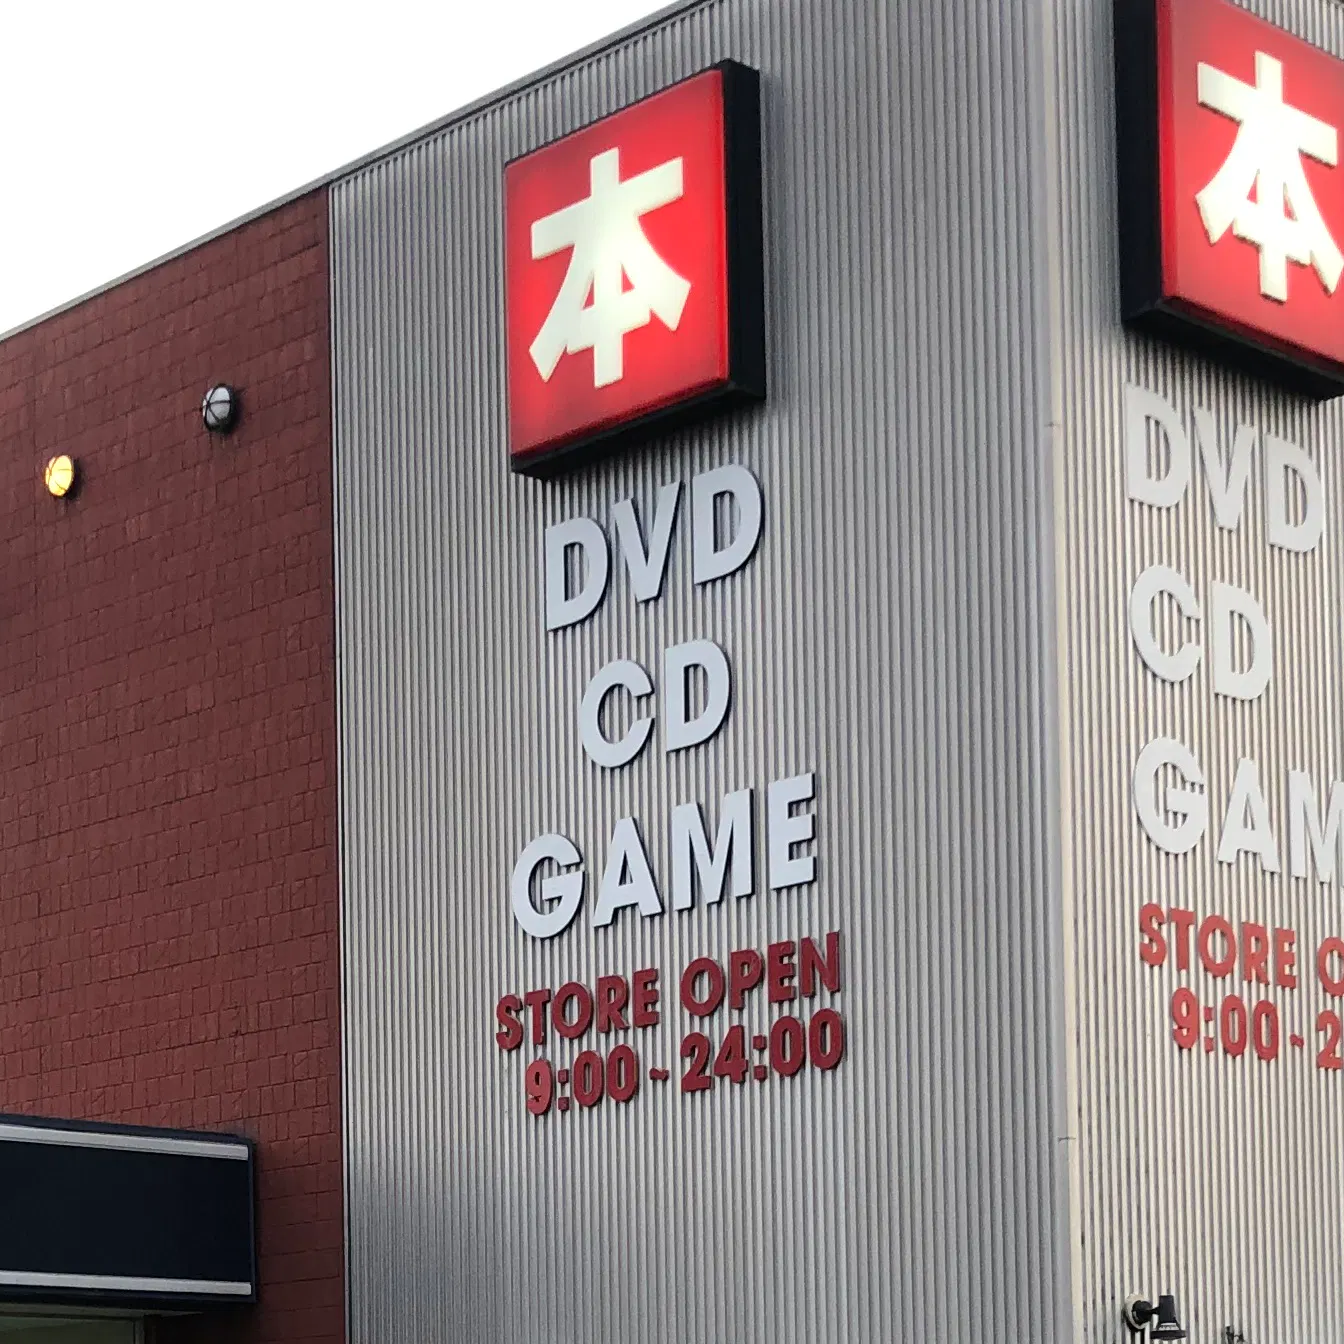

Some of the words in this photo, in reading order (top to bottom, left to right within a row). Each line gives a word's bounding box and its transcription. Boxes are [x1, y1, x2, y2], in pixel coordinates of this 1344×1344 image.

[528, 147, 692, 390] 本
[1124, 383, 1325, 552] DVD
[544, 464, 764, 632] DVD
[578, 638, 733, 768] CD
[1128, 563, 1273, 702] CD
[511, 771, 818, 939] GAME
[495, 966, 659, 1052] STORE
[680, 931, 842, 1019] OPEN
[1139, 903, 1297, 991] STORE
